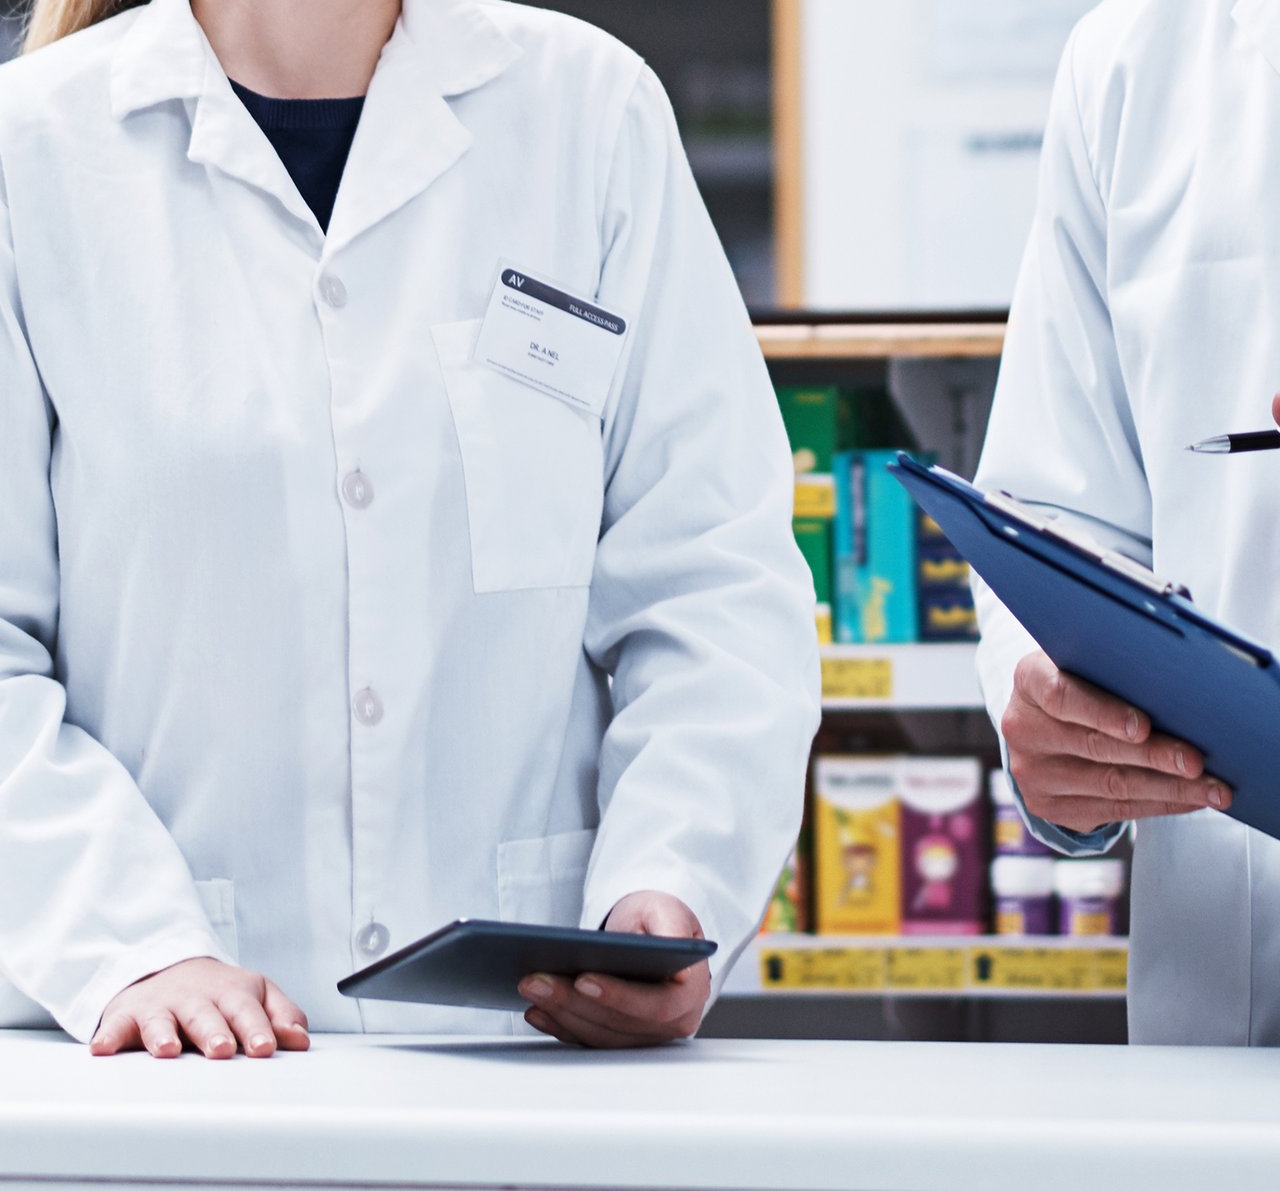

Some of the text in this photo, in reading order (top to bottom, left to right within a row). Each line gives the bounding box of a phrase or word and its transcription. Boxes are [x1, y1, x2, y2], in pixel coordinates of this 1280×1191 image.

[508, 273, 525, 288] AV
[569, 303, 619, 332] FULL ACCESS PASS
[542, 347, 547, 355] A
[547, 349, 560, 361] NEL
